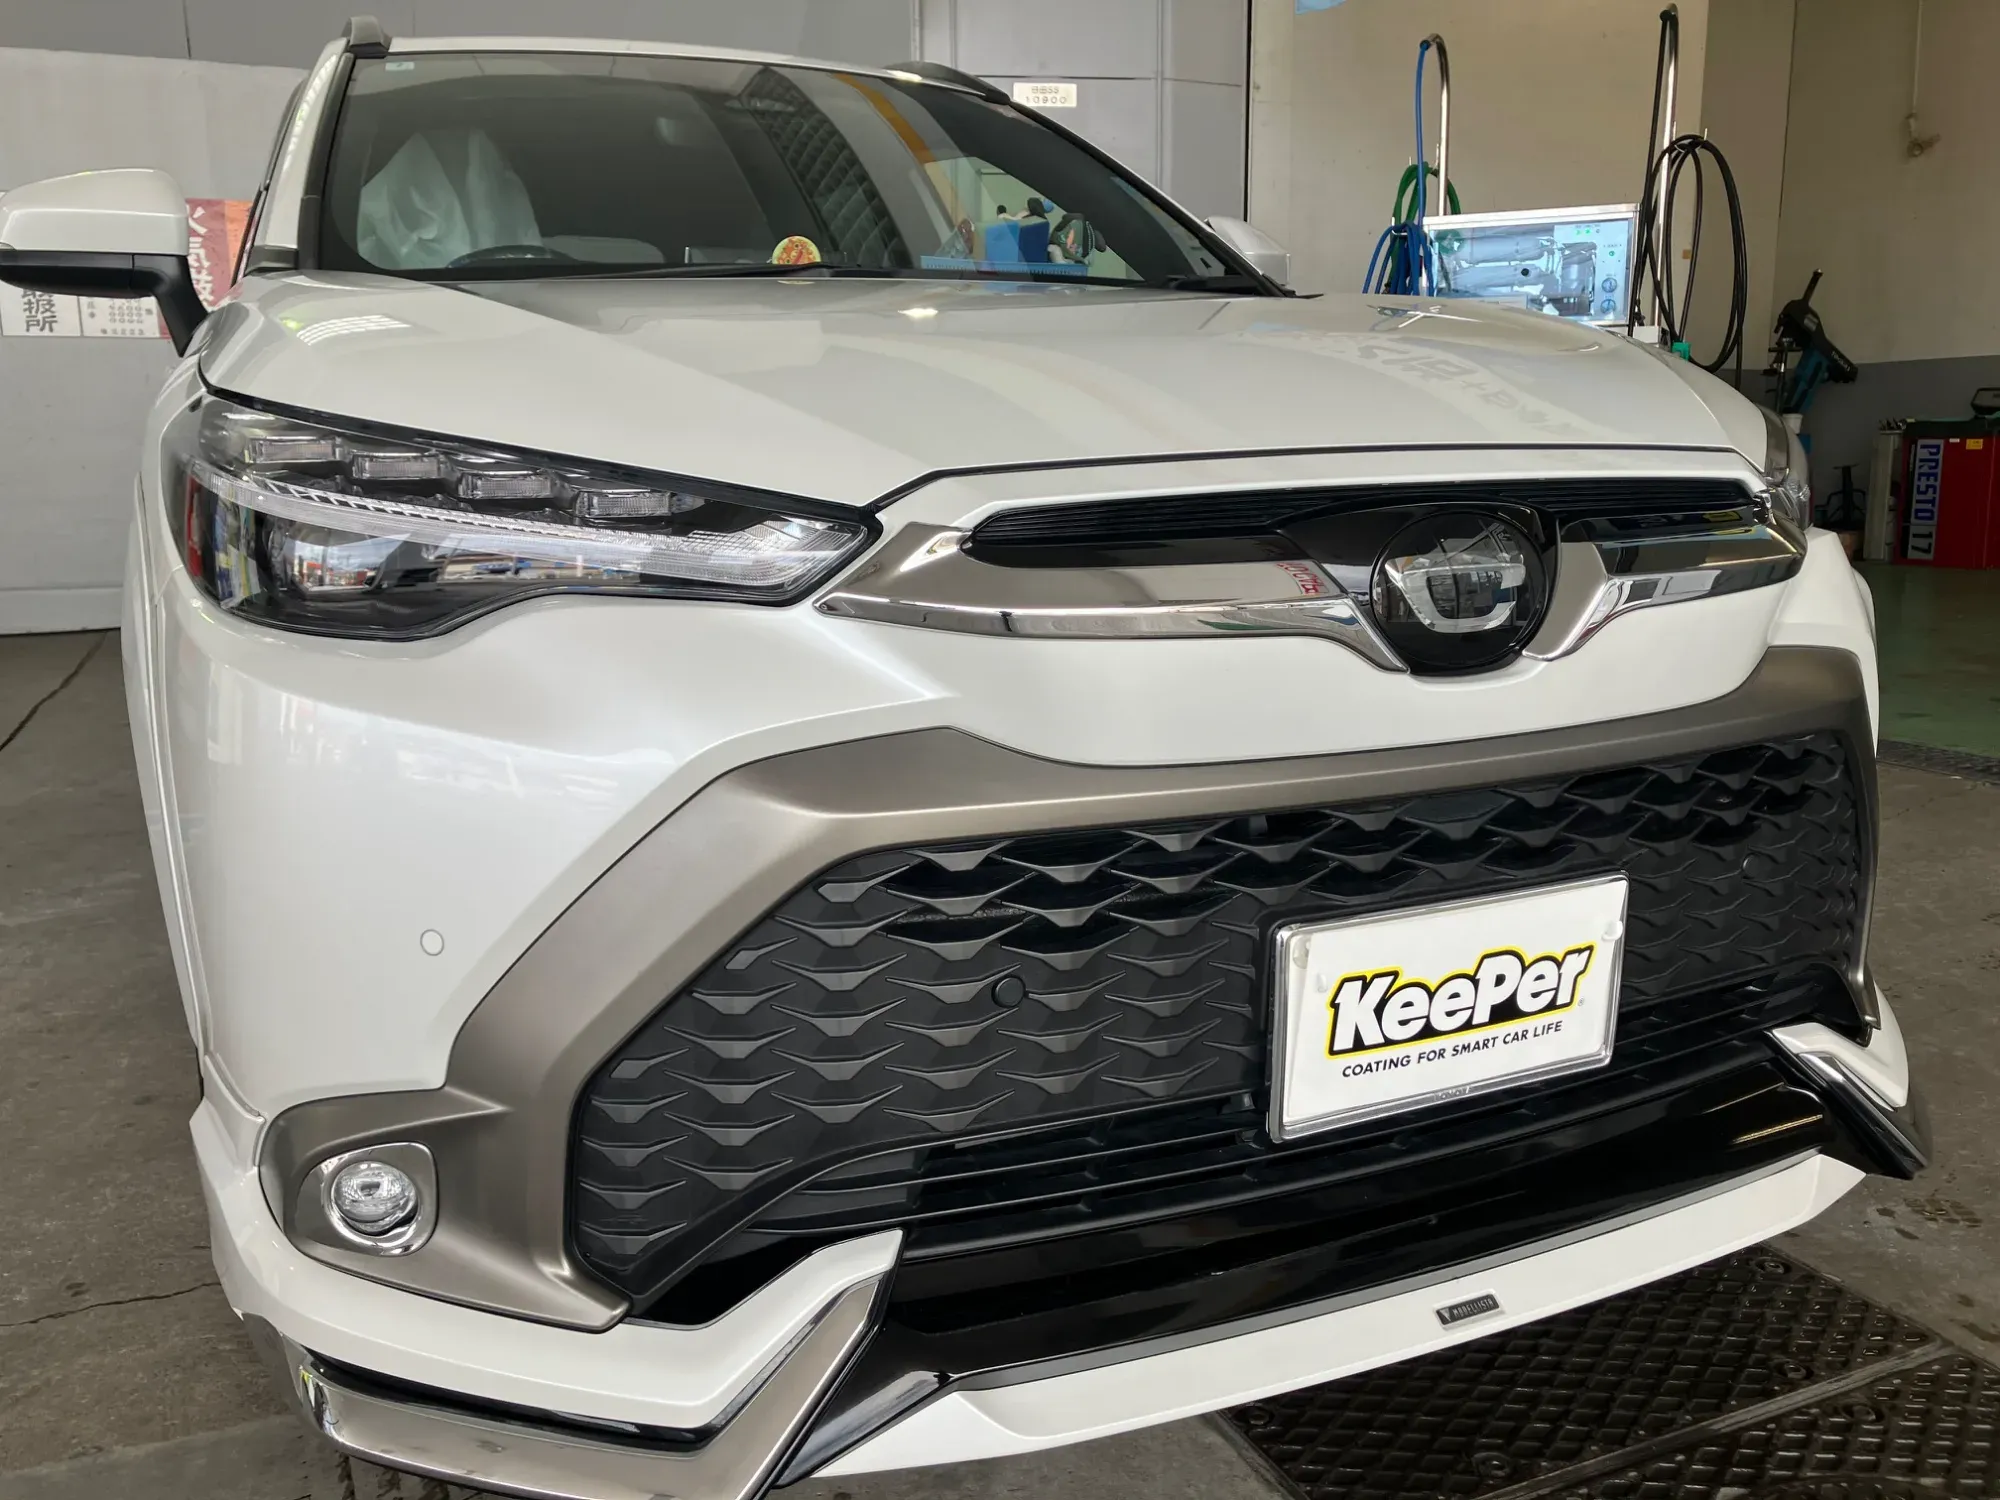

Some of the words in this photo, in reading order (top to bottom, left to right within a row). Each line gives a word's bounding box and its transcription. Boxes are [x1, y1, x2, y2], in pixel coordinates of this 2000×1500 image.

[1913, 443, 1941, 522] PRESTO
[1911, 531, 1934, 555] 17
[1329, 945, 1594, 1056] KeePer
[1342, 1055, 1412, 1078] COATING
[1417, 1047, 1446, 1065] FOR
[1452, 1036, 1499, 1057] SMART
[1503, 1029, 1529, 1046] CAR
[1533, 1020, 1562, 1038] LIFE
